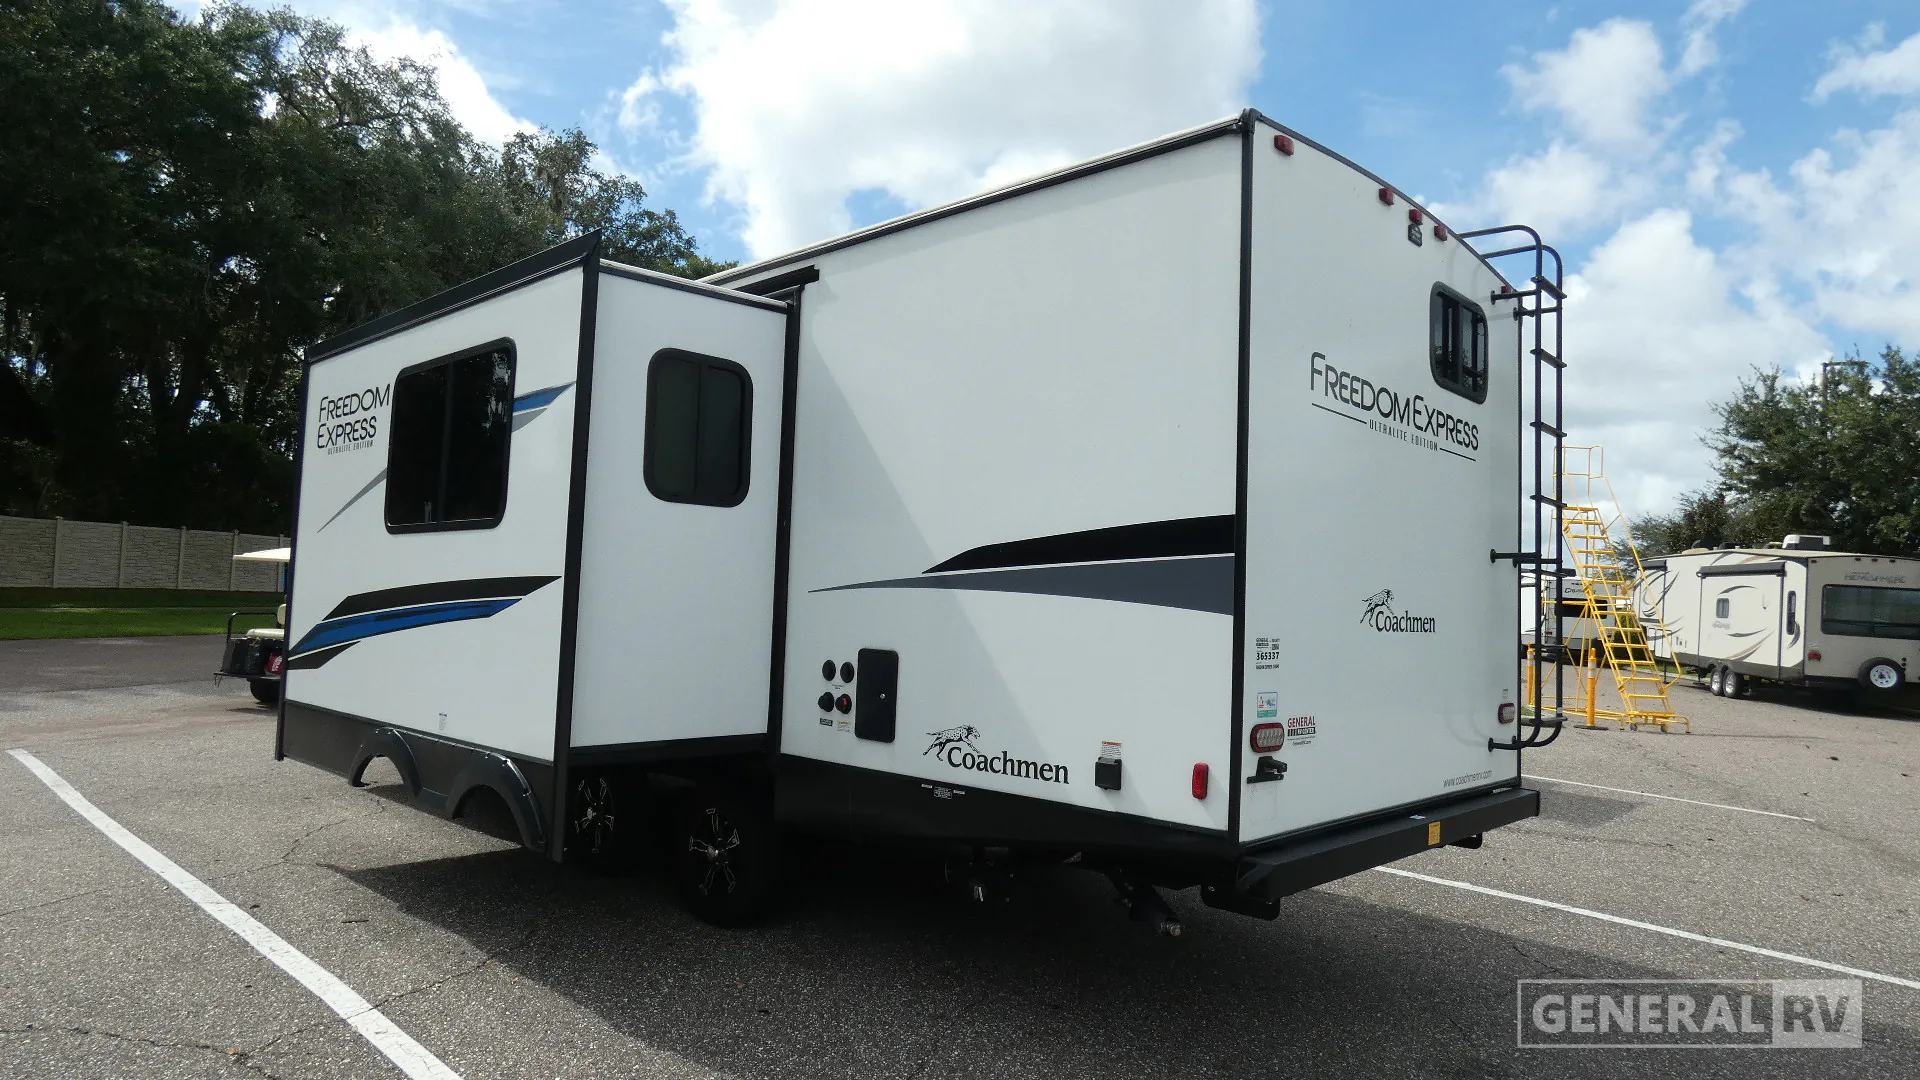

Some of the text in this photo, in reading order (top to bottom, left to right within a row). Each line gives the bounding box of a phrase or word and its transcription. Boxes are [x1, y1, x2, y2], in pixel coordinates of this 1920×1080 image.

[318, 383, 391, 423] FREEDOM
[317, 415, 377, 449] EXPRESS
[353, 439, 374, 450] EDITION
[1369, 418, 1438, 452] ULTRALITE EDITION
[1375, 610, 1436, 633] Coachmen
[1256, 651, 1280, 661] 365337
[1287, 716, 1316, 728] GENERAL
[947, 745, 1070, 785] Coachmen
